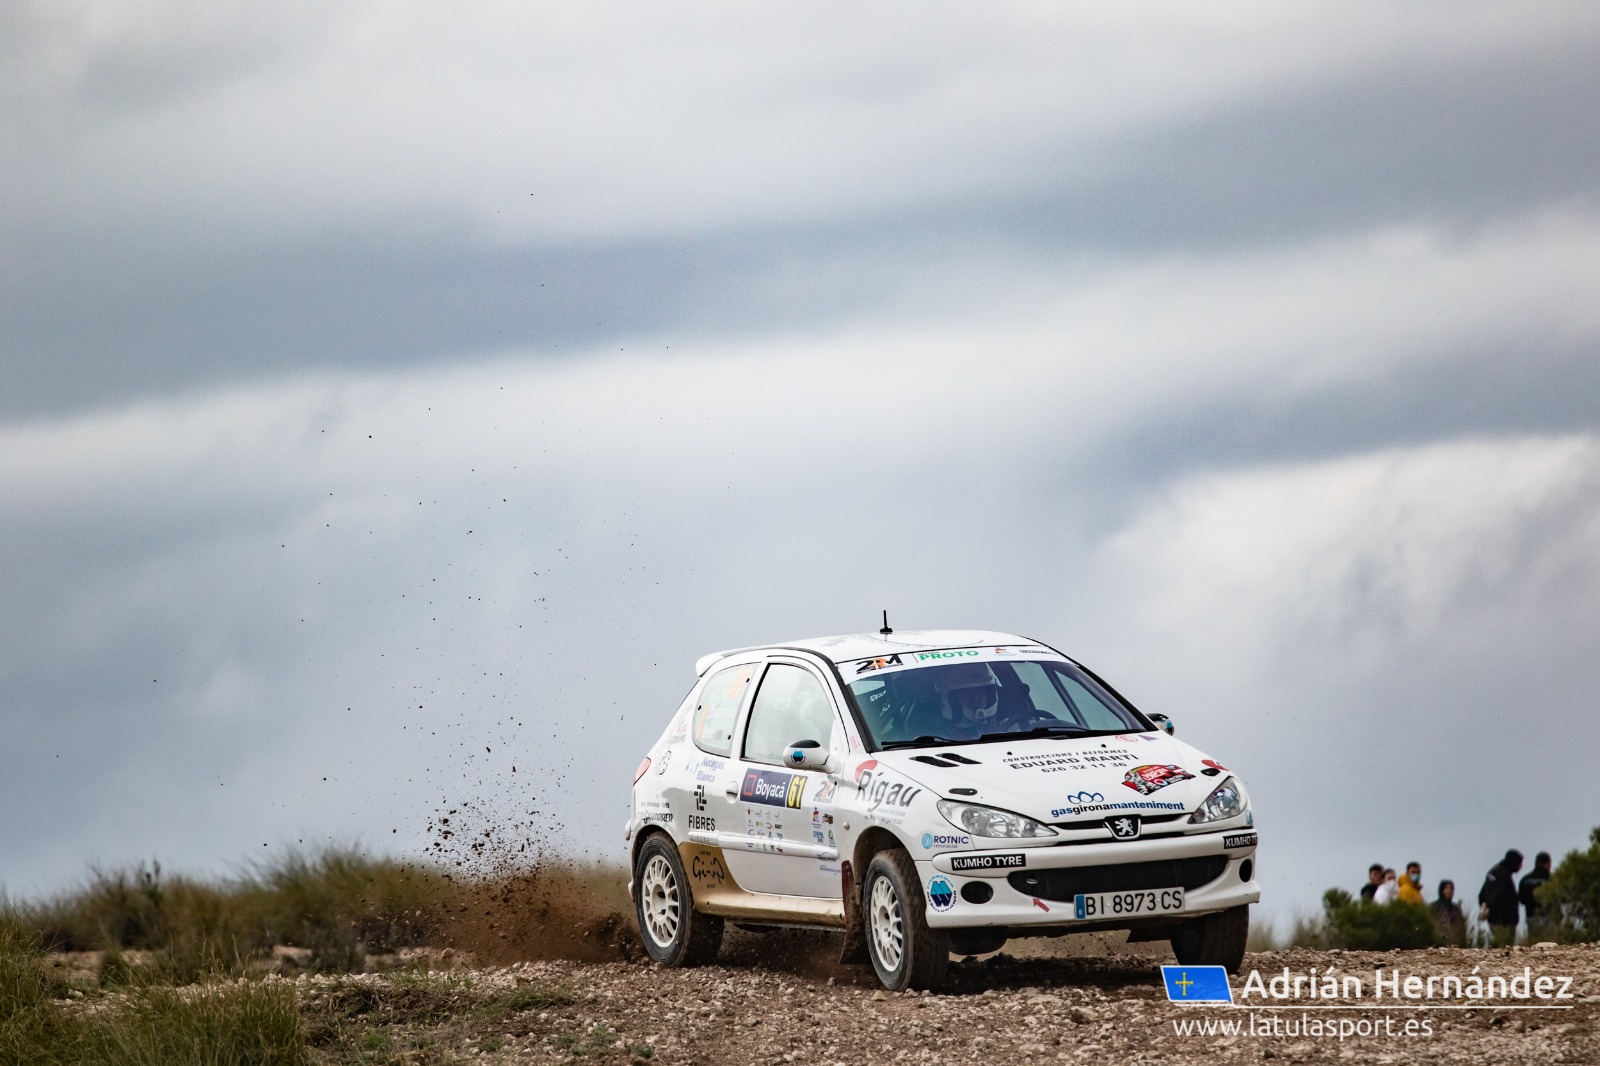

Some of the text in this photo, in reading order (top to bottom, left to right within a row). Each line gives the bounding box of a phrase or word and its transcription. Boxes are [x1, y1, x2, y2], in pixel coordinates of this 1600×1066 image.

[919, 650, 979, 661] PROTO
[1002, 752, 1072, 763] CONSTRUCCIONS
[1010, 757, 1080, 770] EDUARD
[1041, 765, 1067, 773] 626
[755, 776, 806, 808] Boyacá 61
[1051, 800, 1185, 818] gasgironamanteniment
[688, 815, 715, 831] FIBRES
[934, 836, 969, 844] ROTNIC
[1225, 836, 1250, 847] KUMHO
[953, 855, 1023, 869] KUMHO TYRE
[1086, 890, 1182, 916] BI 8973 CS
